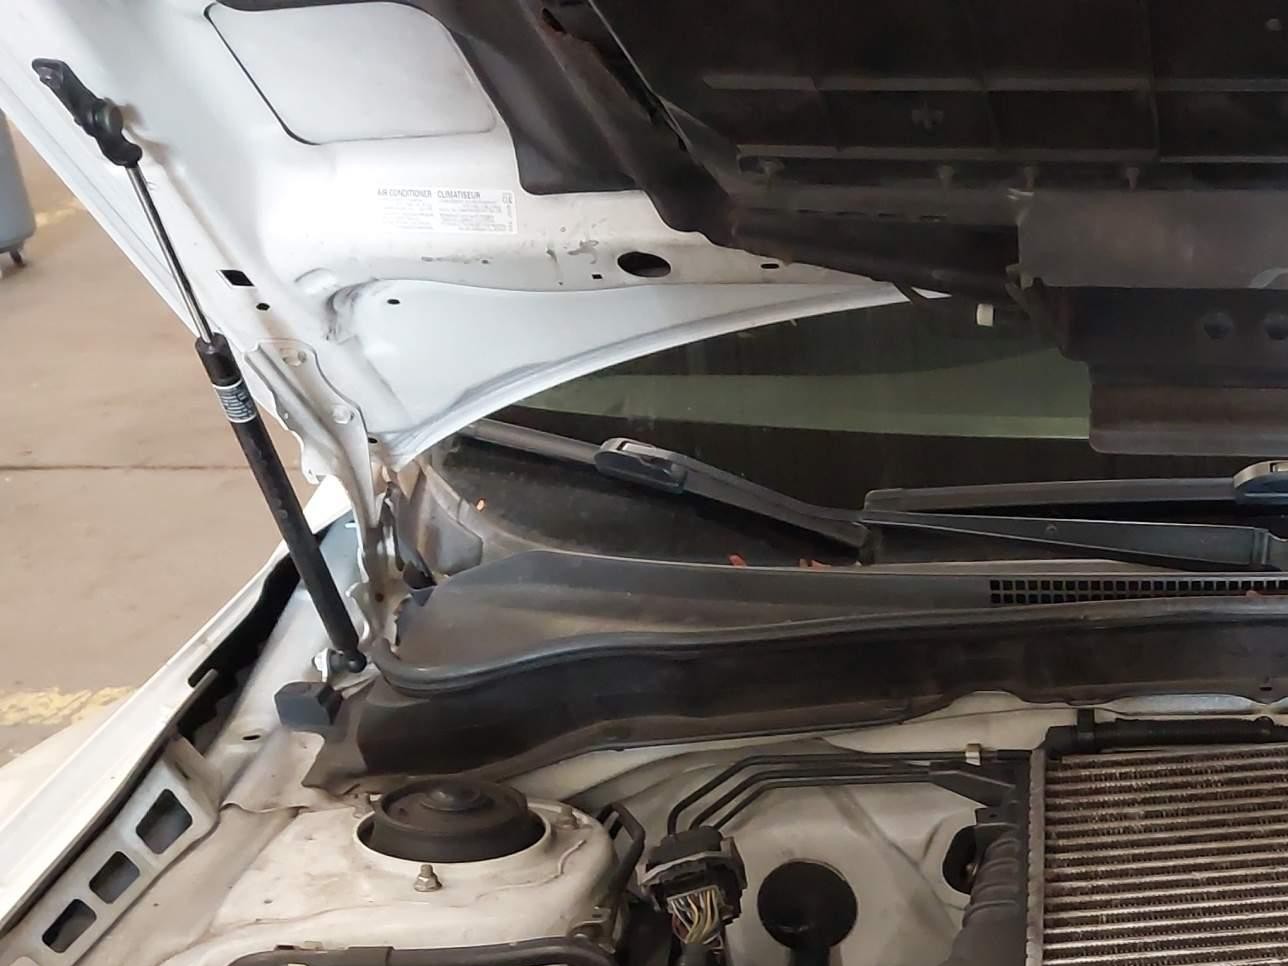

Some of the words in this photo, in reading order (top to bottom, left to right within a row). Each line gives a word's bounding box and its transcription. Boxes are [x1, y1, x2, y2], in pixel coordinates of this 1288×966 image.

[377, 188, 388, 197] AIR
[389, 188, 433, 198] CONDITIONER
[437, 190, 481, 200] CLIMATISEUR
